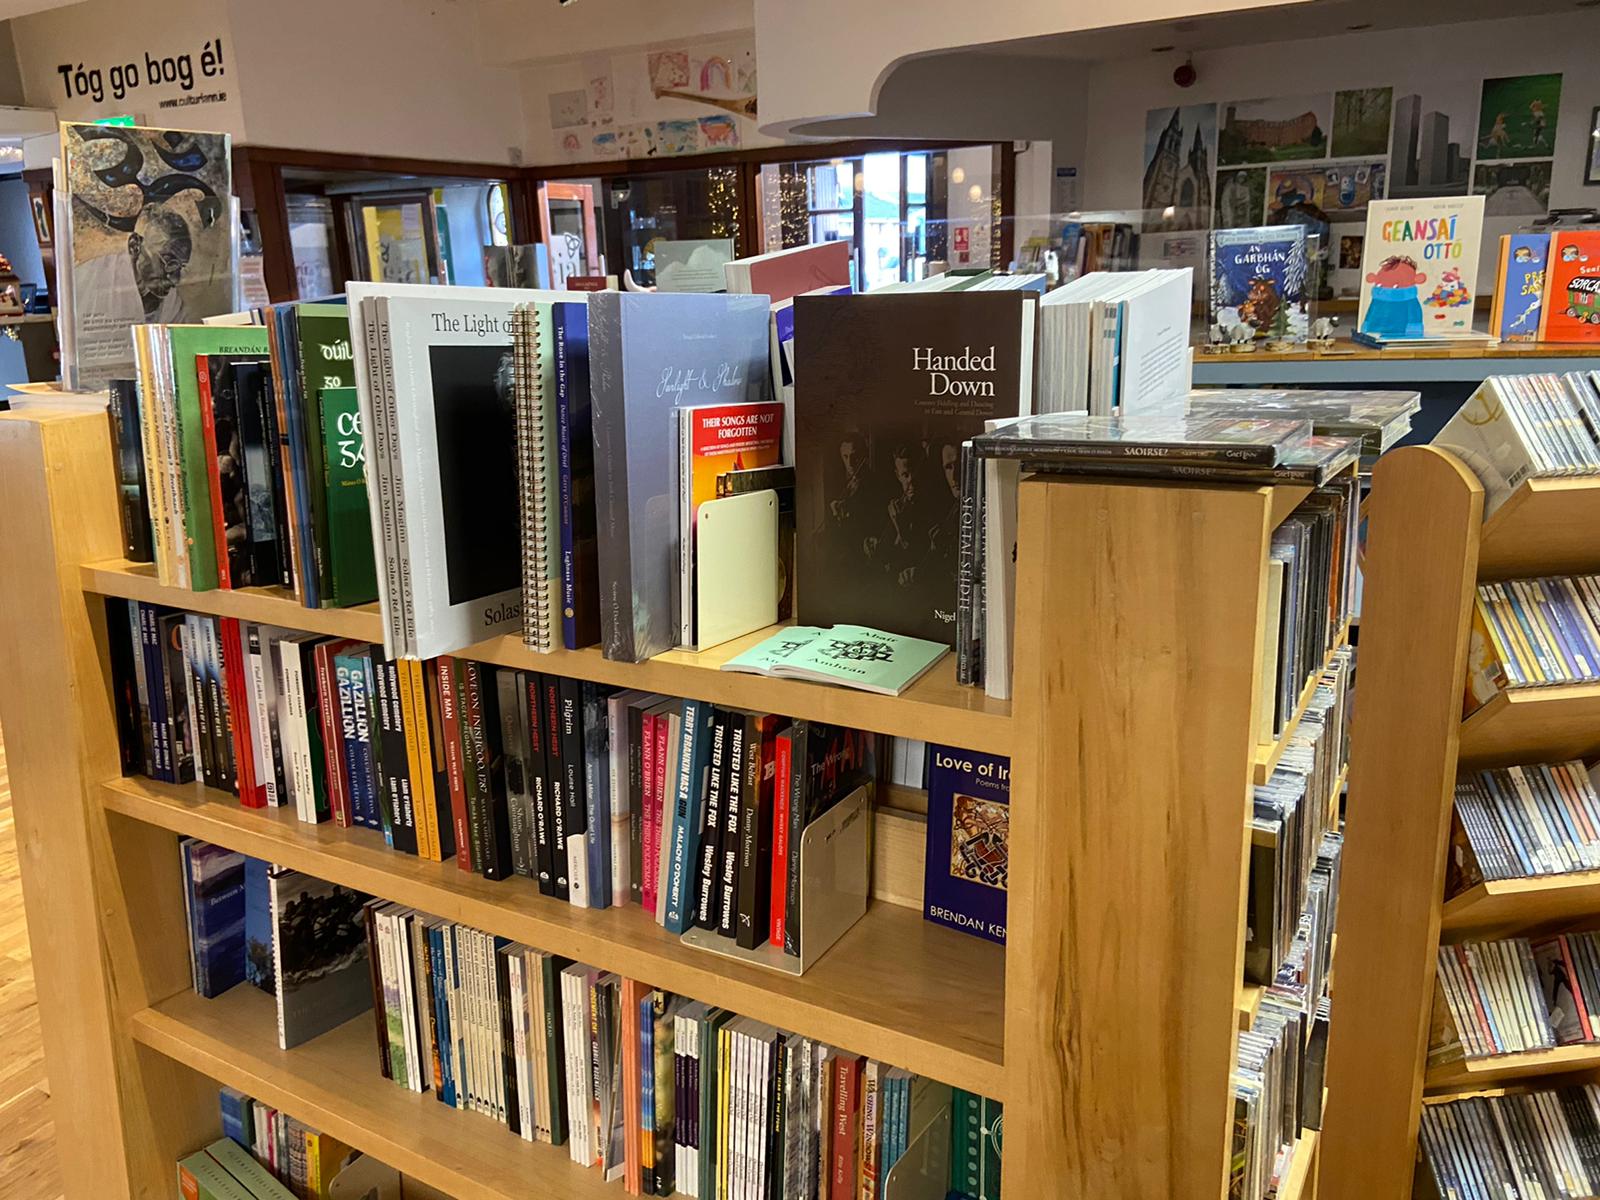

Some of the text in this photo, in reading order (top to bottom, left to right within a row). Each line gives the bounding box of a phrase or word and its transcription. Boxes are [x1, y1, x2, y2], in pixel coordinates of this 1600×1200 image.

[58, 39, 224, 102] Tóg go bog é!
[1382, 214, 1458, 242] GEANSAÍ
[1234, 250, 1285, 264] GARBHÁN
[1424, 239, 1462, 259] OTTÓ
[1255, 262, 1271, 273] ÓG
[432, 313, 513, 337] The Light o
[219, 345, 261, 353] BREANDÁN
[370, 348, 379, 376] Light
[384, 348, 392, 376] Light
[912, 346, 996, 371] Handed
[374, 381, 380, 392] of
[387, 381, 394, 393] of
[699, 372, 710, 388] &
[929, 372, 995, 396] Down
[375, 395, 383, 428] Other
[388, 396, 397, 429] Other
[702, 414, 774, 428] THEIR SONGS ARE NOT
[718, 427, 757, 439] FORGOTTEN
[1124, 447, 1169, 456] SAOIRSE?
[169, 473, 178, 515] Breathnach
[384, 500, 392, 541] Maginn
[397, 500, 406, 543] Maginn
[484, 604, 520, 626] Solas
[859, 631, 899, 642] Abair
[467, 661, 478, 690] LOVE
[196, 681, 205, 713] CONSPIRACY
[210, 684, 220, 716] CONSPIRACY
[336, 667, 355, 739] GAZILLION
[350, 670, 369, 743] GAZILLION
[440, 666, 453, 719] INSIDE MAN
[460, 691, 468, 719] STACEY
[471, 691, 479, 709] ON
[528, 682, 540, 753] NORTHERN HEIST
[548, 686, 559, 757] NORTHERN HEIST
[685, 706, 695, 734] TERRY
[463, 721, 472, 763] PREGNANT?
[563, 700, 577, 807] Pilgrim Louise Hall
[657, 735, 665, 765] FLANN
[681, 734, 693, 772] BRANKIN
[163, 750, 171, 770] DONALD
[747, 743, 757, 786] West Belfast
[936, 752, 972, 773] Love
[978, 763, 994, 777] of
[478, 773, 487, 793] 1787
[656, 767, 665, 802] O'BRIEN
[680, 773, 689, 791] HAS
[707, 725, 723, 828] TRUSTED LIKE THE FOX
[727, 729, 742, 834] TRUSTED LIKE THE FOX
[975, 777, 999, 789] Poems
[535, 777, 546, 845] RICHARD O'RAWE
[678, 800, 687, 818] GUN
[790, 788, 800, 814] Wrong
[510, 798, 521, 852] Connaughton
[553, 781, 564, 850] RICHARD O'RAWE
[588, 817, 596, 833] Quiet
[655, 824, 663, 846] THIRD
[743, 808, 754, 867] Danny Morrison
[643, 843, 651, 889] POLICEMAN
[671, 825, 685, 908] MALACHI O'DOHERTY
[790, 850, 799, 905] Danny Morrison
[699, 845, 714, 921] Wesley Burrowes
[721, 851, 735, 929] Wesley Burrowes
[930, 905, 984, 932] BRENDAN
[591, 1021, 599, 1034] DAY
[591, 1041, 599, 1065] GABRIEL
[776, 1092, 781, 1100] ON
[838, 1067, 849, 1136] Travelling West
[866, 1080, 876, 1121] WASHING
